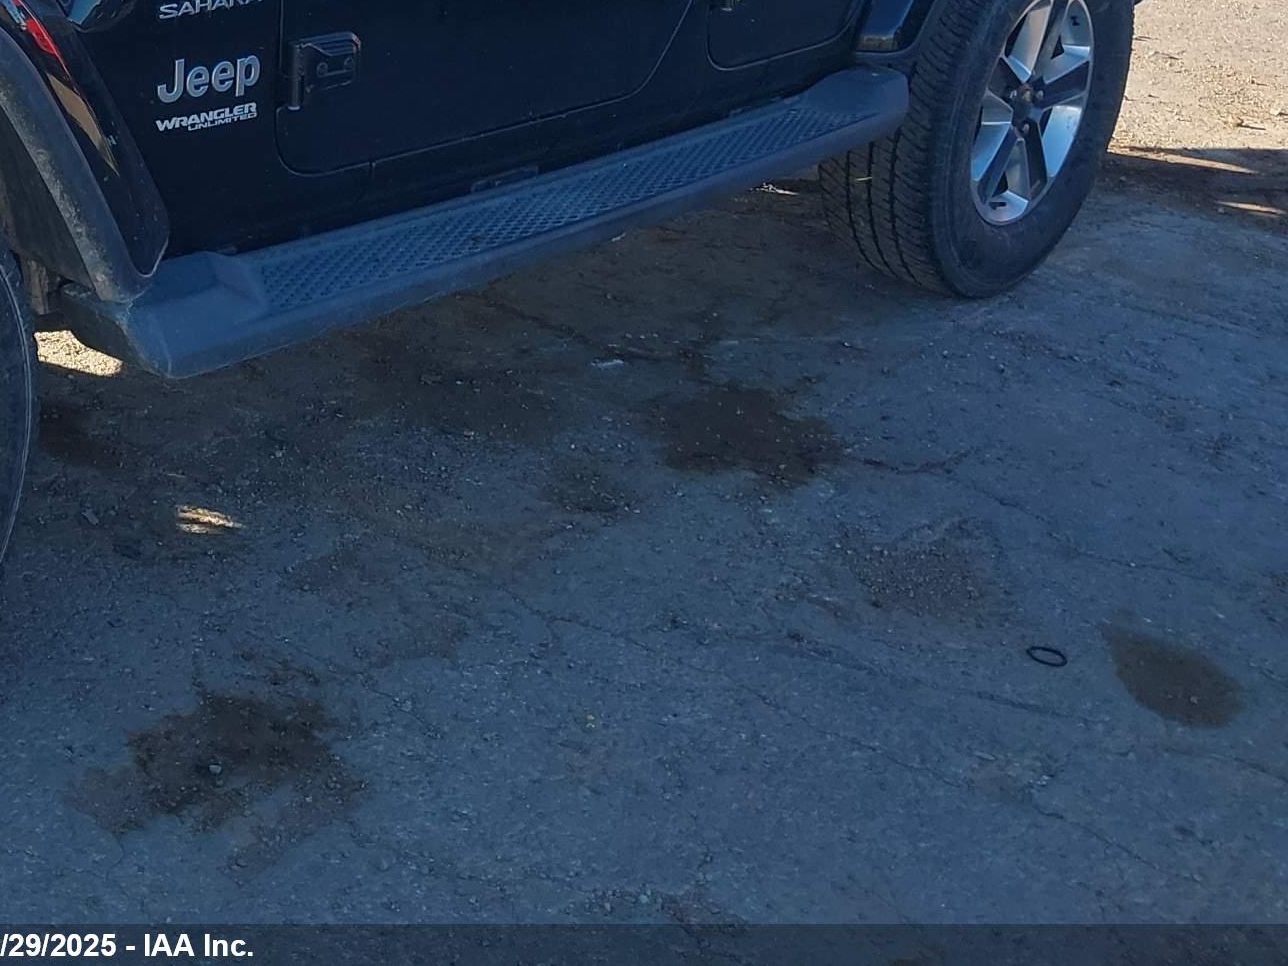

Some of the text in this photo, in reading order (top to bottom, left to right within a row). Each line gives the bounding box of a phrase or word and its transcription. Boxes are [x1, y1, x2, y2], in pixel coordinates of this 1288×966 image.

[157, 55, 261, 103] Jeep
[155, 102, 258, 132] WRANGLER
[187, 112, 258, 132] UNLIMITED
